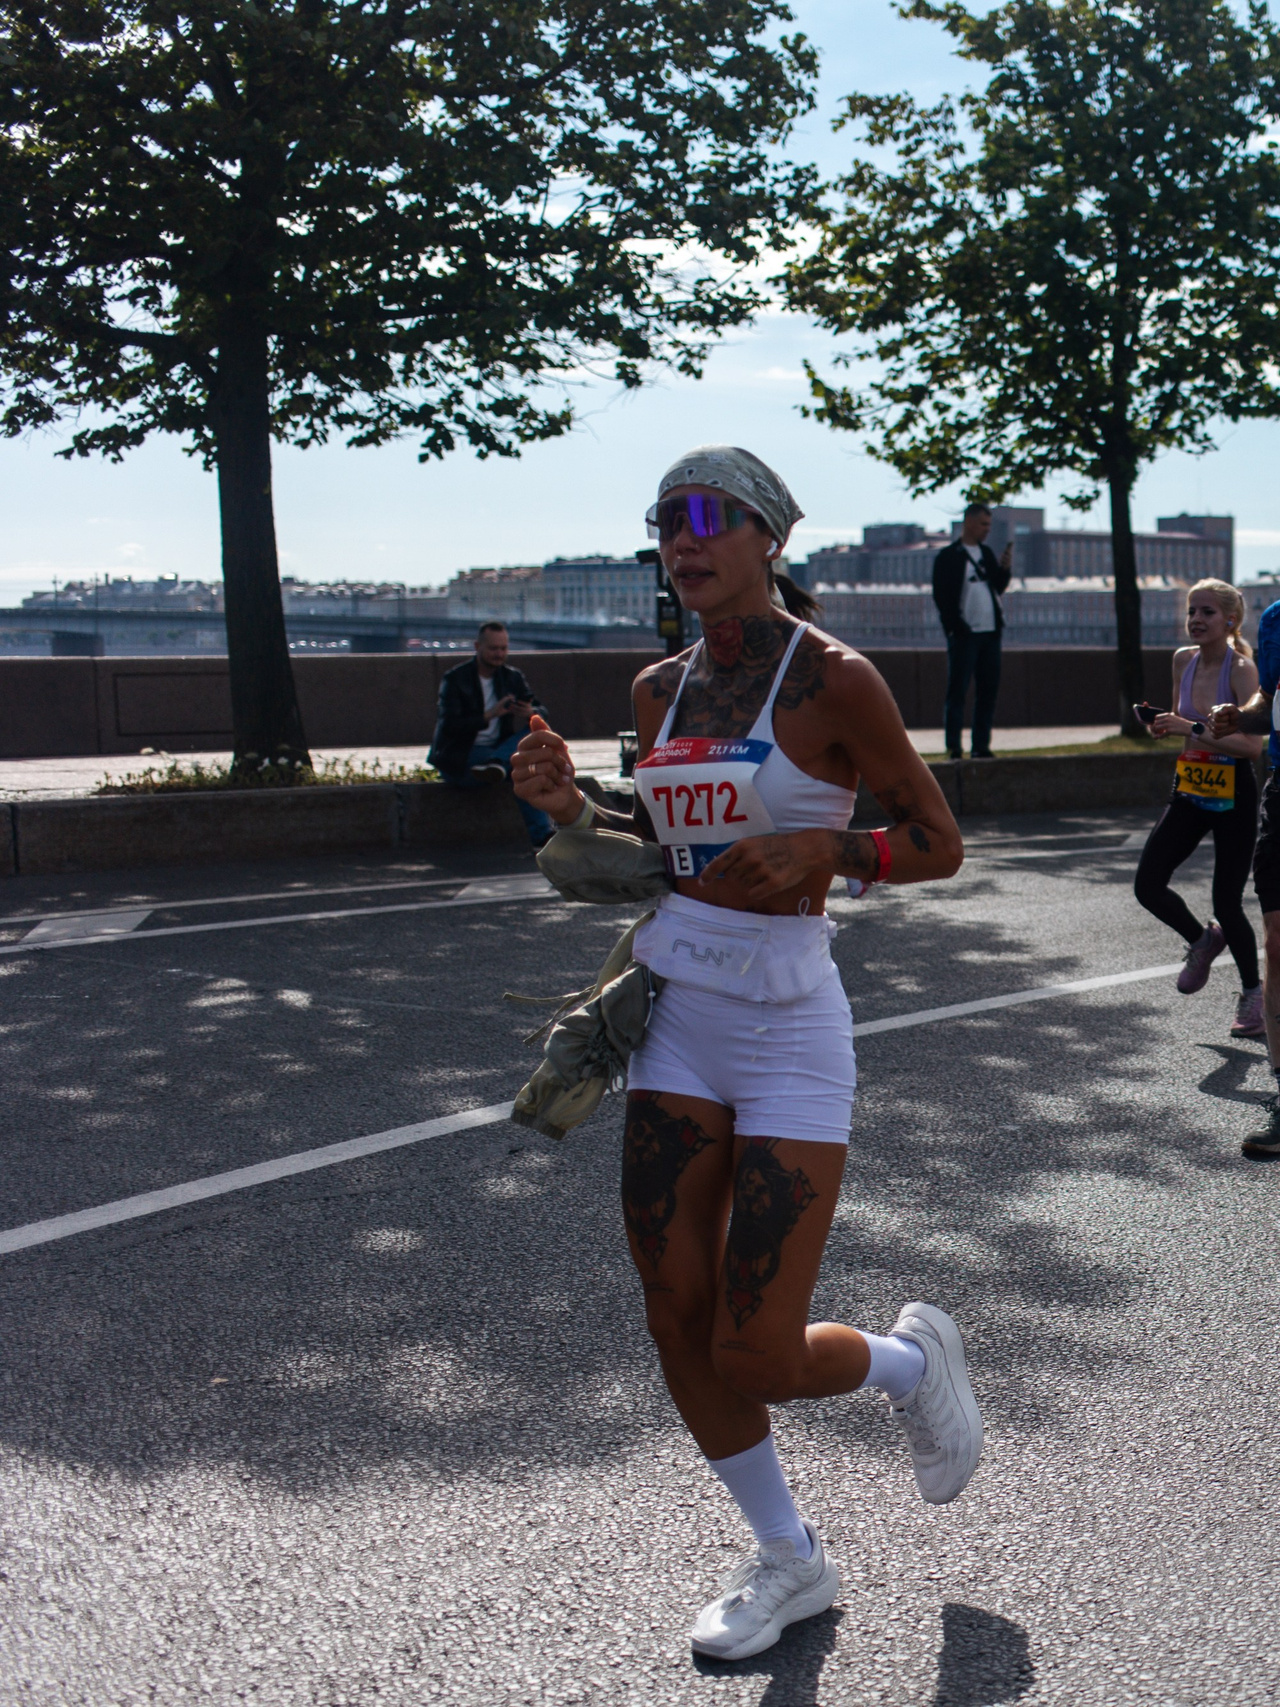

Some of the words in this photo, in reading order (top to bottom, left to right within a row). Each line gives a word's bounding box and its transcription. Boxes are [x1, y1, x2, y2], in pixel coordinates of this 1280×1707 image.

[708, 745, 728, 755] 21,1
[1183, 765, 1227, 788] 3344
[652, 781, 749, 828] 7272
[675, 847, 690, 872] E
